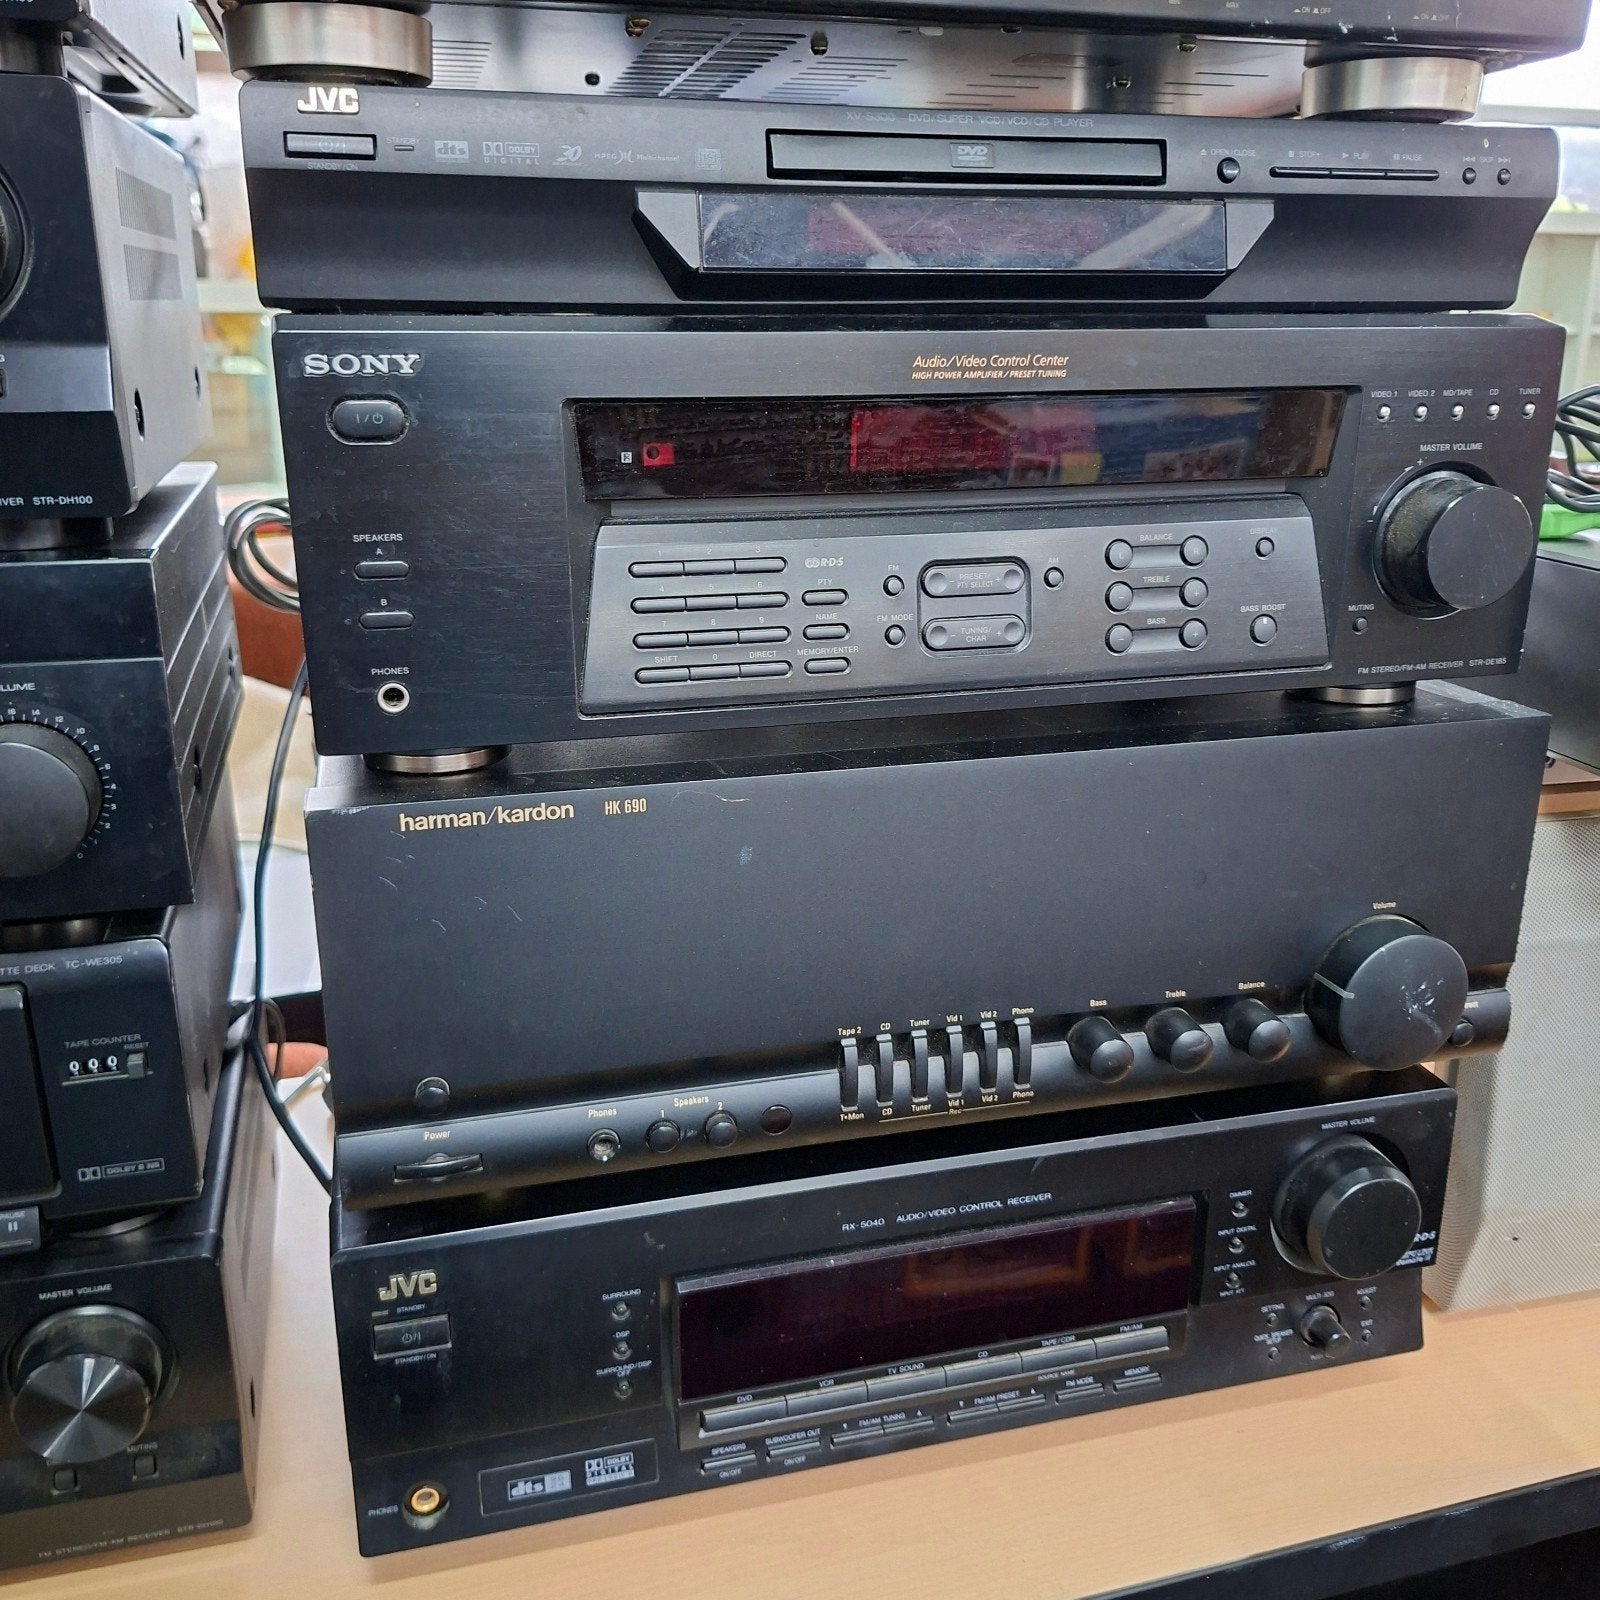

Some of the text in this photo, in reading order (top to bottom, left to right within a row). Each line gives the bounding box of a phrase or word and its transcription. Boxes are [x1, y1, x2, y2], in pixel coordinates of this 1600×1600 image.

[297, 87, 359, 114] JVC
[1053, 118, 1094, 127] PLAYER
[436, 142, 467, 157] dts
[508, 145, 536, 154] DOLBY
[957, 146, 988, 156] DVD
[1210, 149, 1257, 157] OPEN/CLOSE
[484, 157, 540, 165] DIGITAL
[303, 353, 421, 375] SONY
[912, 354, 1069, 368] Audio/Video Control Center
[912, 371, 932, 380] HIGH
[933, 371, 962, 379] POWER
[1037, 369, 1067, 378] TUNING
[1371, 390, 1393, 398] VIDEO
[1408, 389, 1436, 397] VIDEO 2
[1443, 388, 1473, 397] MD/TAPE
[1489, 388, 1499, 396] CD
[1519, 387, 1541, 396] TUNER
[1420, 442, 1483, 452] MASTER VOLUME
[0, 495, 93, 506] IVER STR-DH100
[352, 533, 403, 543] SPEAKERS
[1139, 533, 1173, 541] BALANCE
[959, 572, 991, 580] PRESET/
[1143, 575, 1170, 583] TREBLE
[970, 580, 994, 588] SELECT
[380, 598, 387, 606] B
[1262, 603, 1287, 611] BOOST
[1348, 603, 1375, 611] MUTING
[815, 612, 838, 620] NAME
[891, 613, 914, 621] MODE
[1146, 617, 1166, 625] BASS
[961, 626, 992, 635] TUNING/
[966, 635, 987, 643] CHAR
[749, 650, 777, 659] DIRECT
[797, 645, 859, 655] MEMORY/ENTER
[654, 655, 679, 664] SHIFT
[371, 666, 410, 676] PHONES
[1371, 663, 1427, 674] STEREO/FM-AM
[1429, 660, 1464, 669] RECEIVER
[55, 715, 64, 723] 12
[399, 798, 648, 832] harman/kardon HK 690
[1372, 901, 1397, 910] Volume
[0, 955, 123, 976] TTE DECK TC-WE305
[1238, 980, 1265, 990] Balance
[1165, 989, 1187, 998] Treble
[1089, 999, 1108, 1007] Bass
[980, 1010, 997, 1019] Vid 2
[1012, 1006, 1034, 1015] Phono
[909, 1018, 930, 1027] Tuner
[946, 1014, 958, 1022] Vid
[837, 1026, 862, 1036] Tape 2
[880, 1022, 891, 1031] CD
[64, 1033, 142, 1049] TAPE COUNTER
[981, 1095, 993, 1103] Vid
[1013, 1090, 1034, 1099] Phono
[673, 1095, 709, 1108] Speakers
[717, 1102, 723, 1110] 2
[882, 1107, 893, 1116] CD
[911, 1103, 931, 1112] Tuner
[588, 1107, 617, 1119] Phones
[1321, 1116, 1375, 1130] MASTER VOLUME
[424, 1130, 451, 1141] Power
[842, 1192, 1052, 1232] RX-5040 AUDIO/VIDEO CONTROL RECEIVER
[1218, 1228, 1234, 1236] INPUT
[1213, 1260, 1256, 1272] INPUT ANALOG
[378, 1269, 437, 1300] JVC
[38, 1283, 113, 1300] MASTER VOLUME
[602, 1288, 641, 1301] SURROUND
[396, 1303, 425, 1313] STANDBY
[615, 1330, 631, 1338] DSP
[1041, 1335, 1075, 1347] TAPE/CDR
[977, 1350, 988, 1358] CD
[596, 1360, 652, 1376] SURROUND/DSP
[887, 1362, 925, 1375] TV SOUND
[819, 1379, 835, 1387] VCR
[1065, 1376, 1094, 1387] FM MODE
[736, 1394, 753, 1403] DVD
[997, 1390, 1020, 1401] PRESET
[883, 1412, 906, 1423] TUNING
[805, 1427, 821, 1438] OUT
[711, 1442, 746, 1456] SPEAKERS
[511, 1480, 544, 1497] dts
[368, 1505, 399, 1516] PHONES
